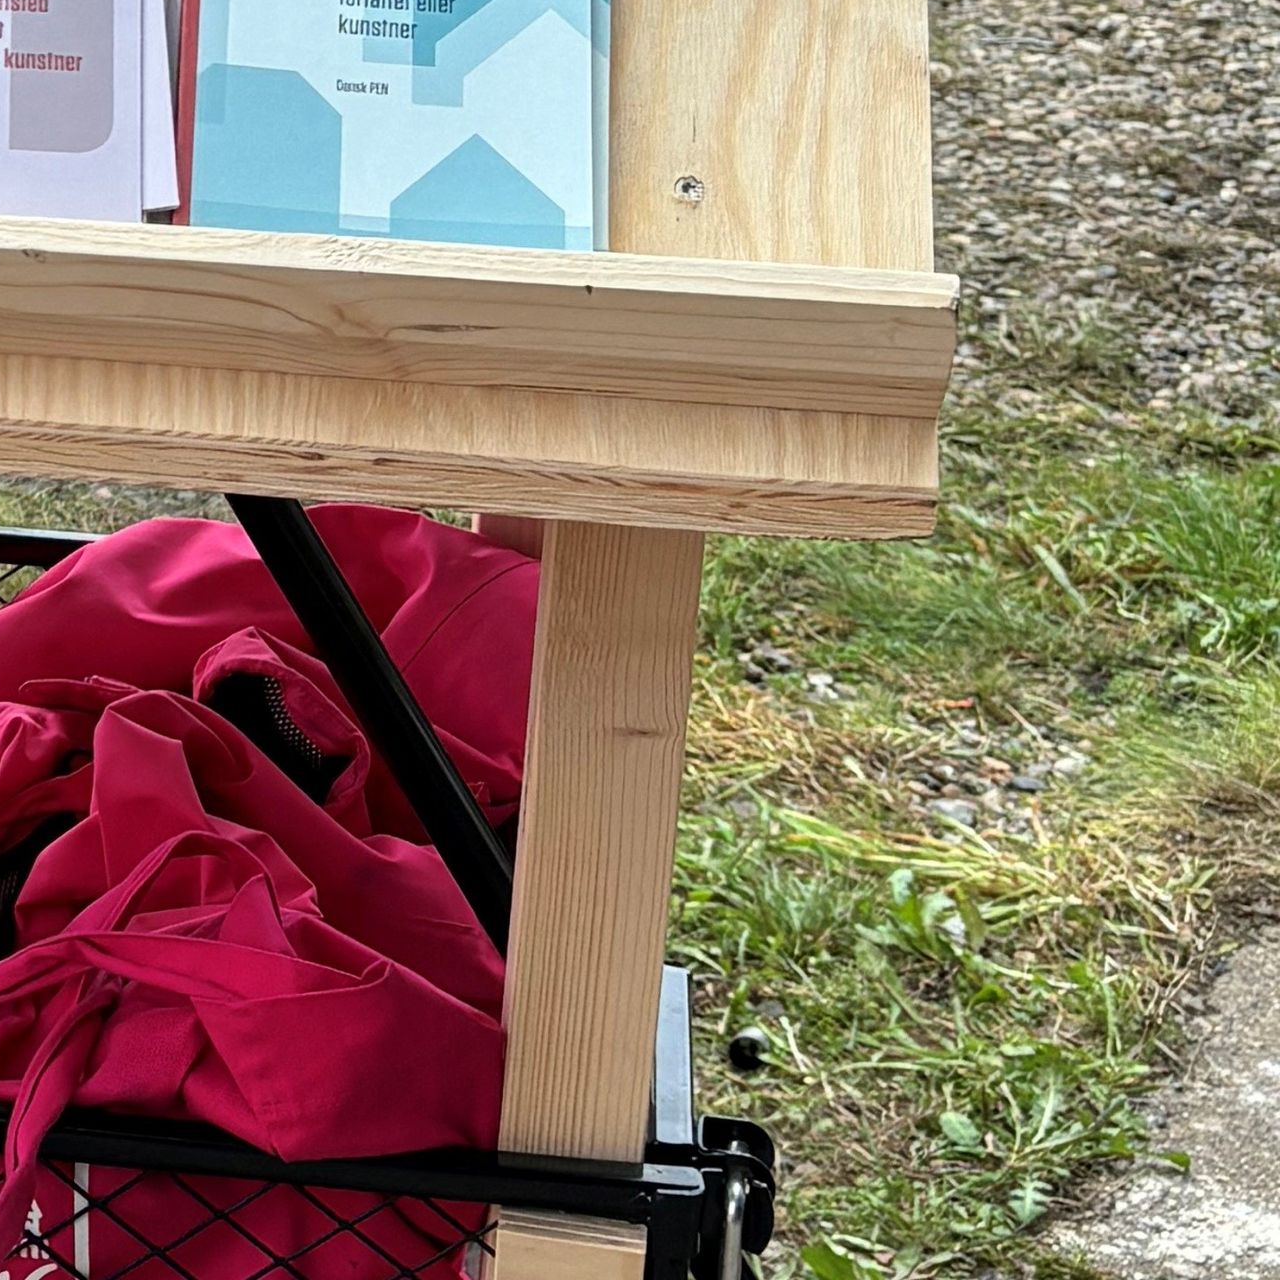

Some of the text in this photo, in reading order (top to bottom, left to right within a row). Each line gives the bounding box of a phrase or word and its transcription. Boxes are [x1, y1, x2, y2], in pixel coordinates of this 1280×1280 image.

[338, 14, 418, 40] kunstner
[4, 48, 83, 72] kunstner
[336, 79, 389, 96] Dansk PEN
